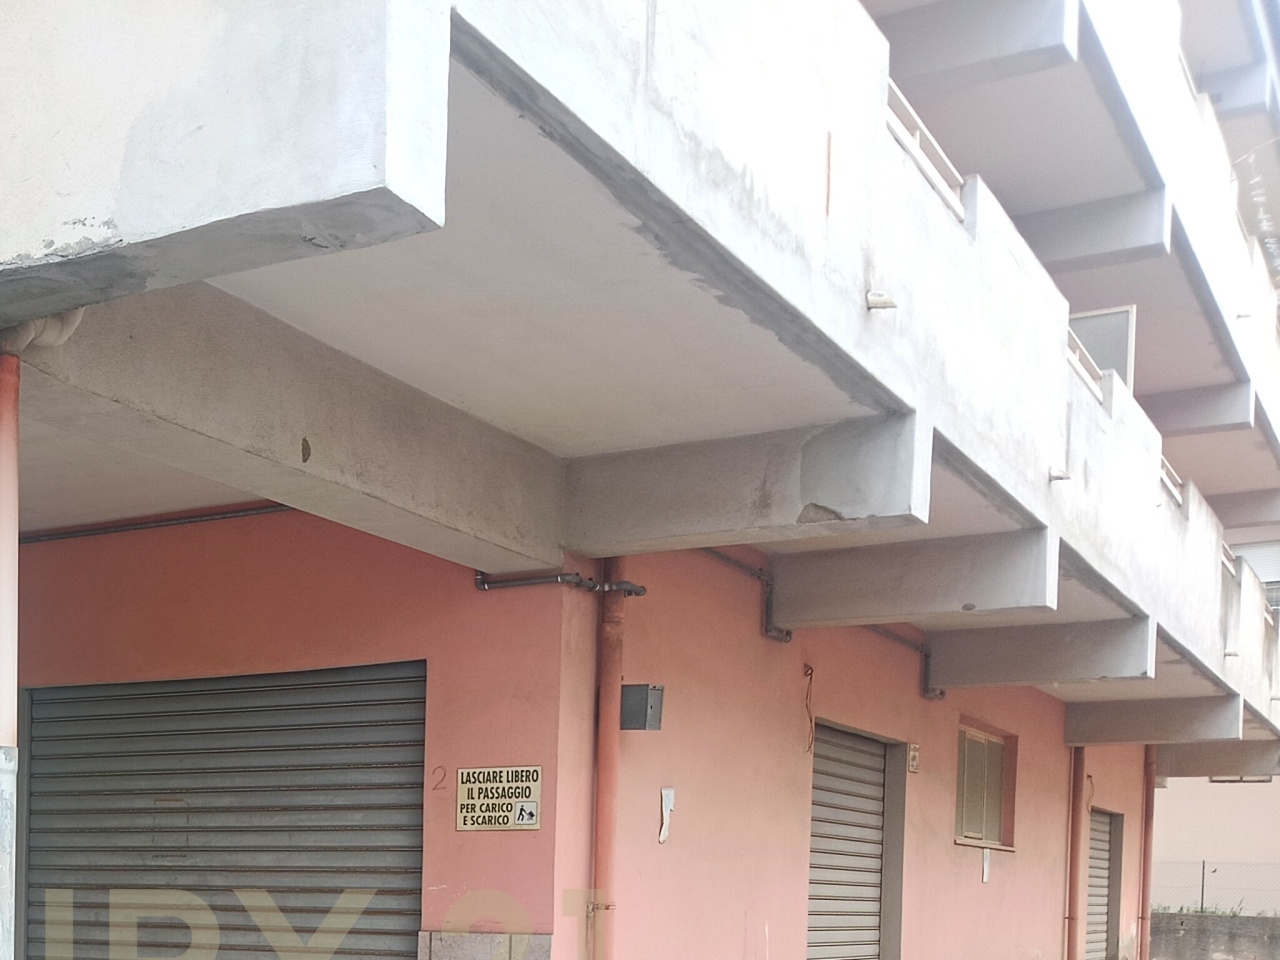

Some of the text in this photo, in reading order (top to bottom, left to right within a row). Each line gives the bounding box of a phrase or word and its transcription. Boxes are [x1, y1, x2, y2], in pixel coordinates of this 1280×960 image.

[431, 765, 447, 791] 2
[460, 769, 539, 785] LASCIARE LIBERO
[467, 786, 532, 800] IL PASSAGGIO
[460, 802, 513, 814] PER CARICO
[463, 815, 510, 826] E SCARICO
